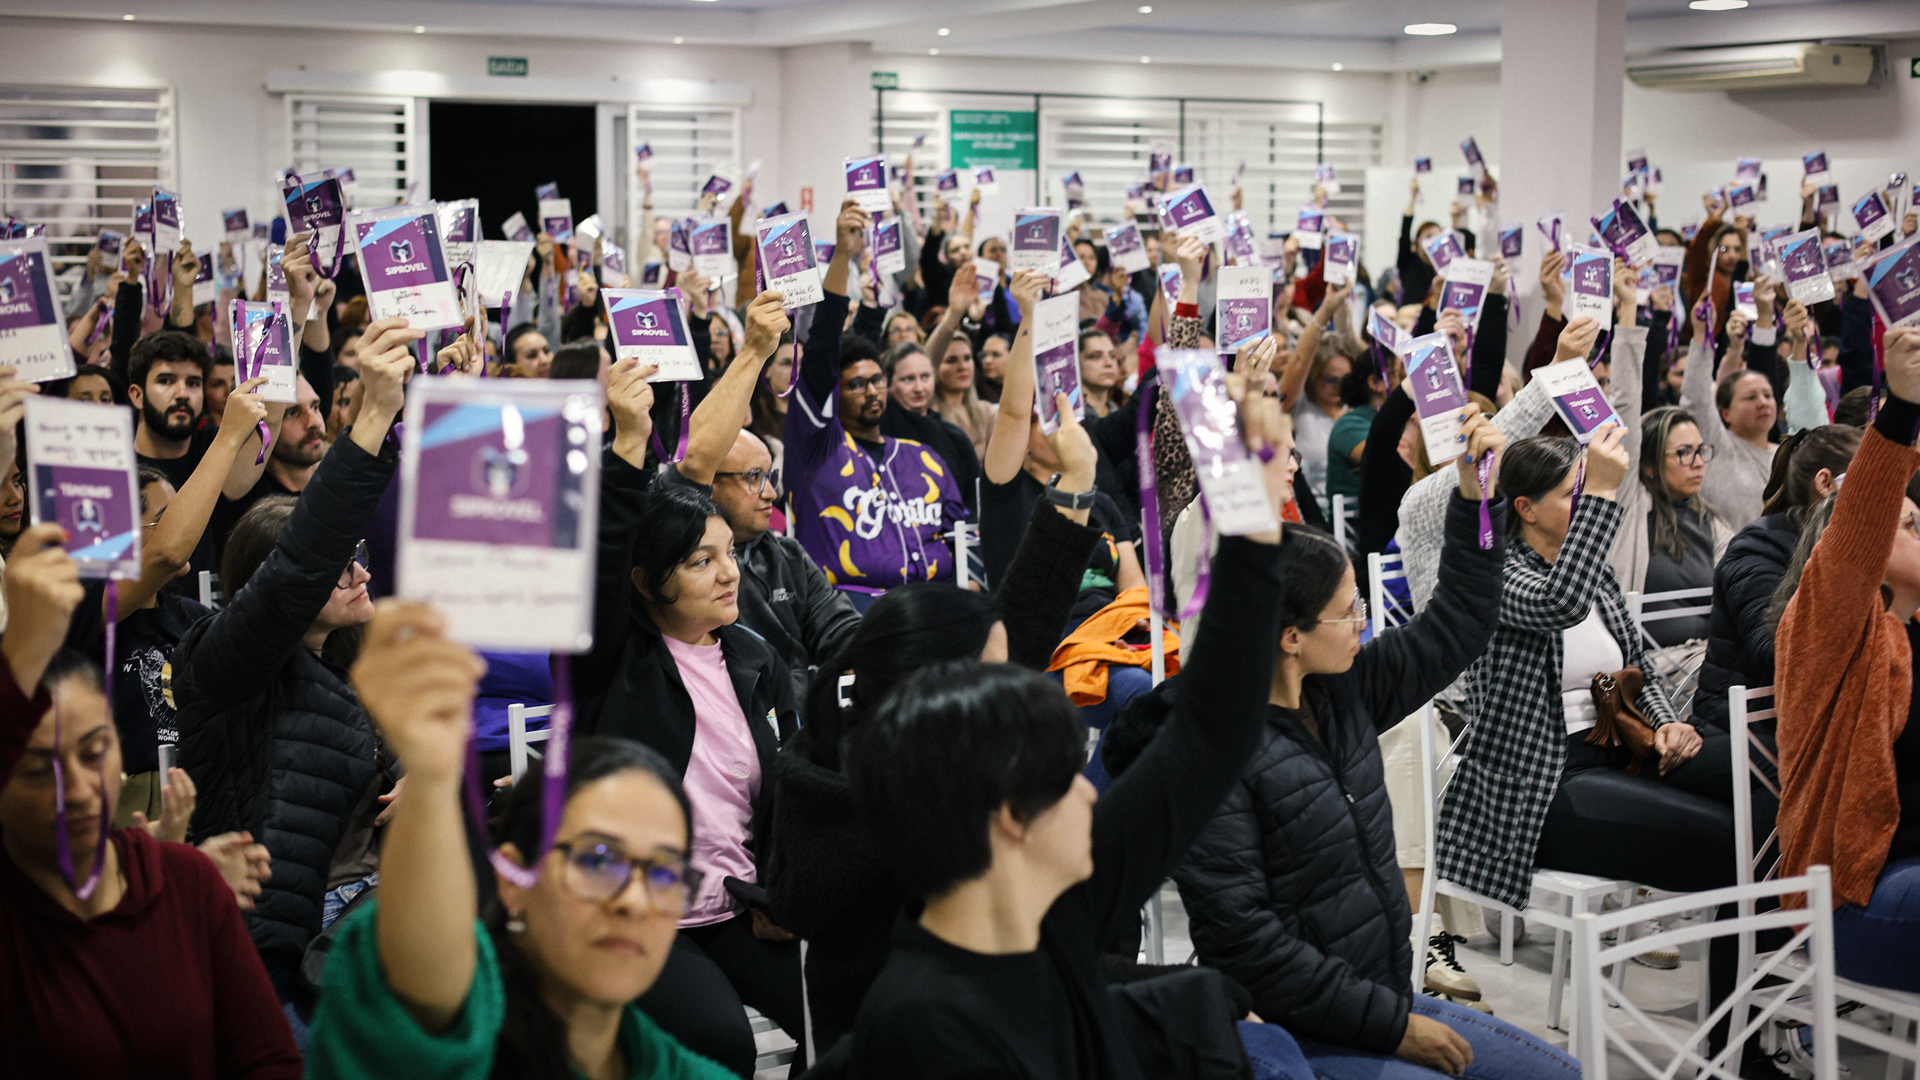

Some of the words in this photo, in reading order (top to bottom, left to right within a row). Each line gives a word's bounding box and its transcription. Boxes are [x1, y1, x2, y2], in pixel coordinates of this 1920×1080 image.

[303, 211, 331, 222] SIPROVEL
[778, 254, 804, 267] SIPROVEL
[385, 262, 427, 276] SIPROVEL
[1484, 530, 1494, 550] OVEL
